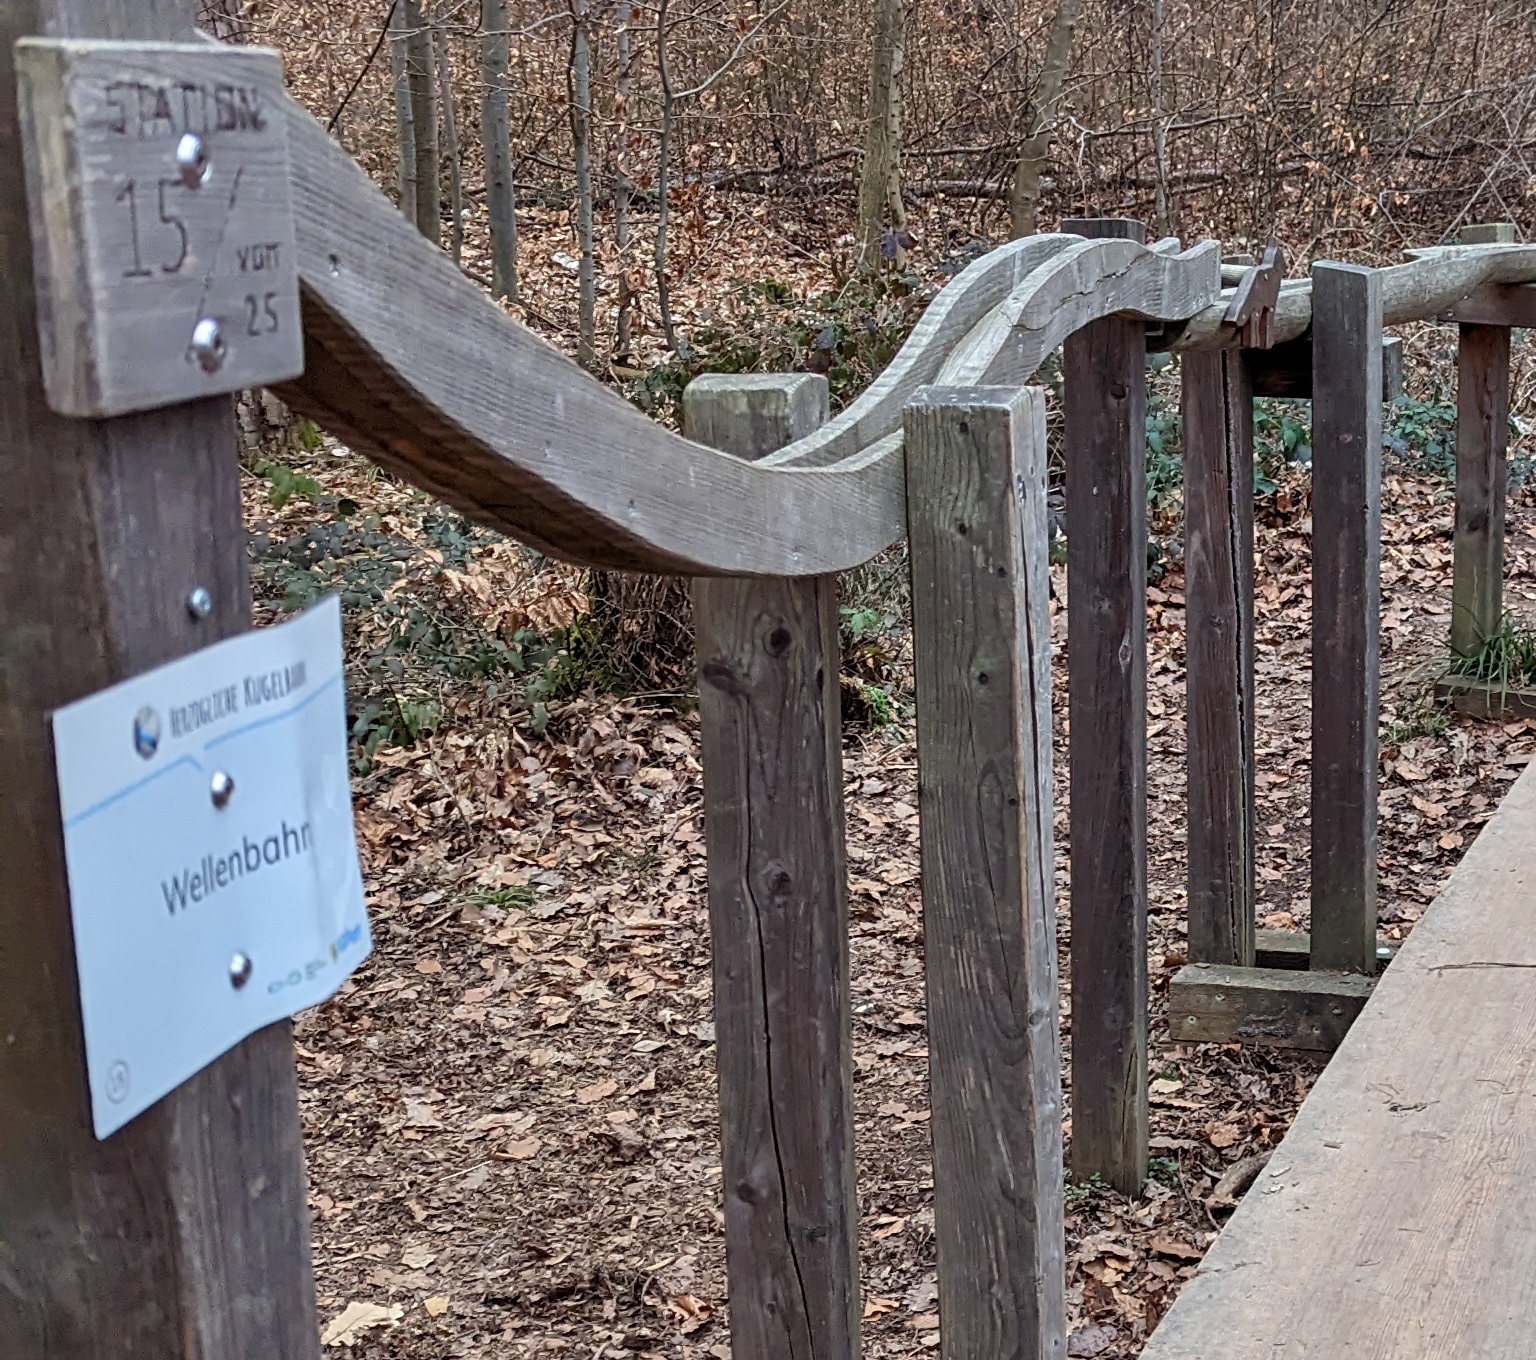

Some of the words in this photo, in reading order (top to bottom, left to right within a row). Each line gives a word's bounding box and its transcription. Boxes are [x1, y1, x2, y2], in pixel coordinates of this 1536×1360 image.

[116, 177, 188, 277] 15
[244, 290, 279, 336] 25
[160, 818, 315, 917] Wellenbahn
